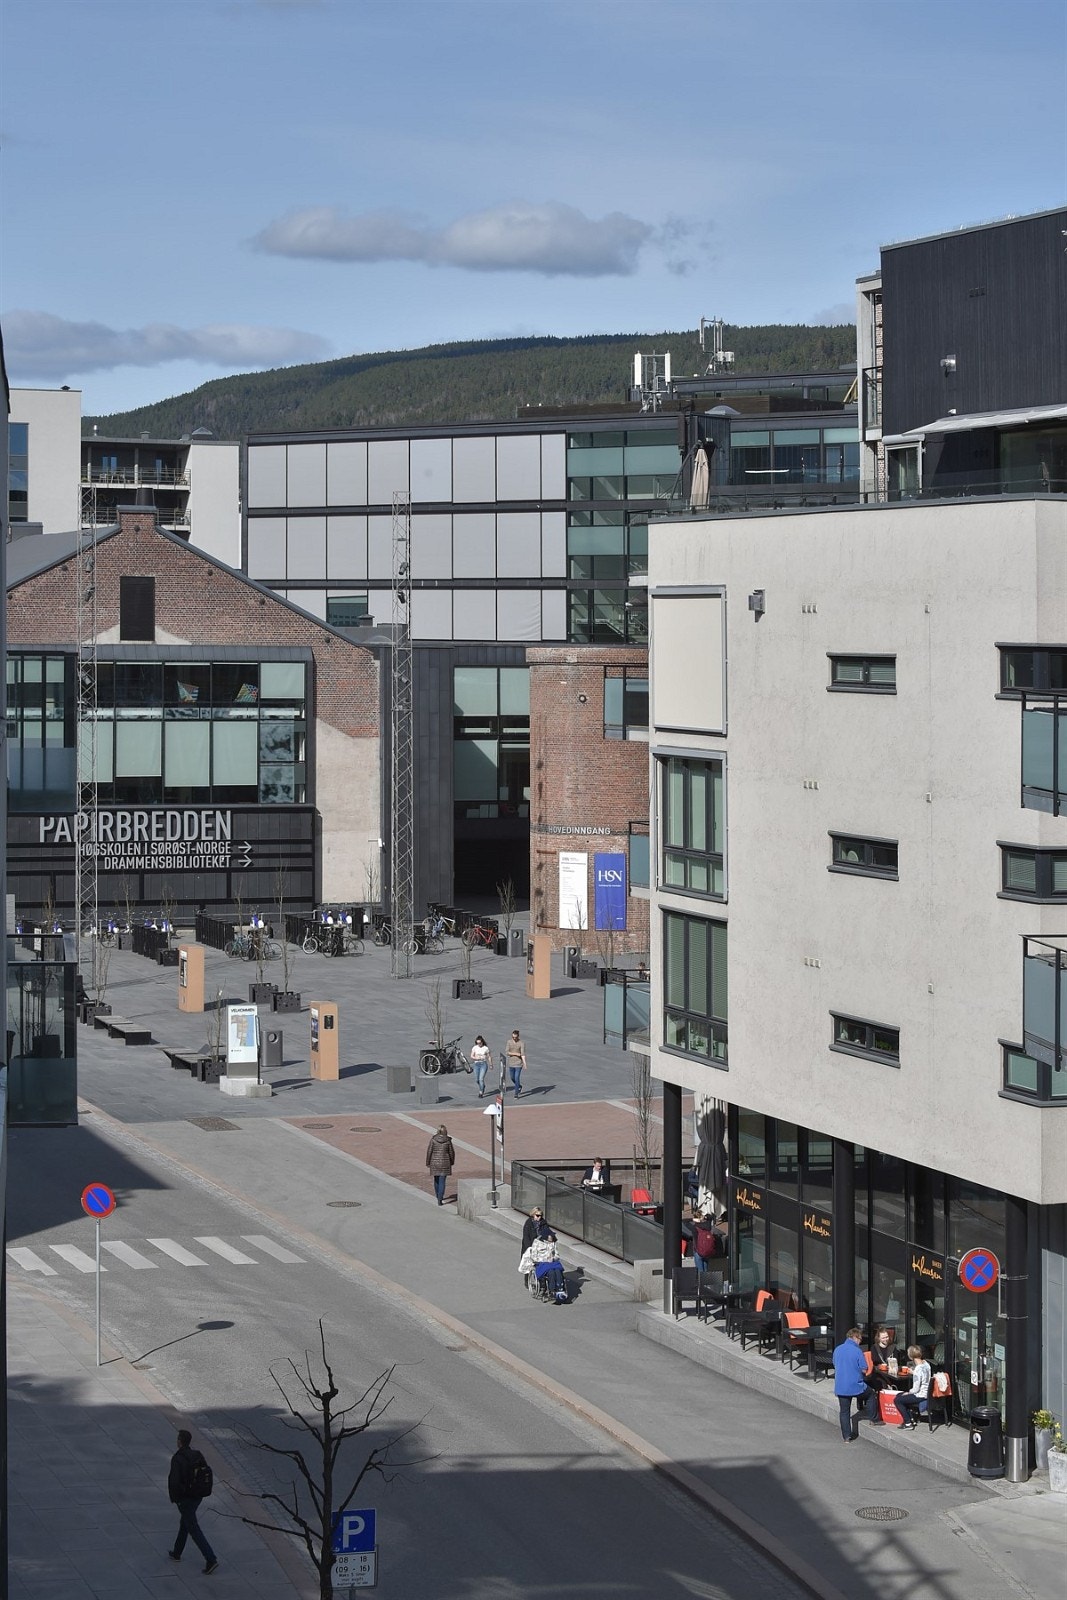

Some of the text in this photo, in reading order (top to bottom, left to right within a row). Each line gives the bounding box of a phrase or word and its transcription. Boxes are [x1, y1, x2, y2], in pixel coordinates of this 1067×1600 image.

[39, 810, 231, 842] PAPIRBREDDEN
[549, 826, 611, 835] HOVEDINNGANG
[79, 841, 231, 856] HØGSKOLEN I SØRØST-NORGE
[104, 855, 231, 870] DRAMMENSBIBLIOTEKET
[598, 870, 623, 882] HSN
[343, 1516, 365, 1549] P
[335, 1565, 349, 1574] (09
